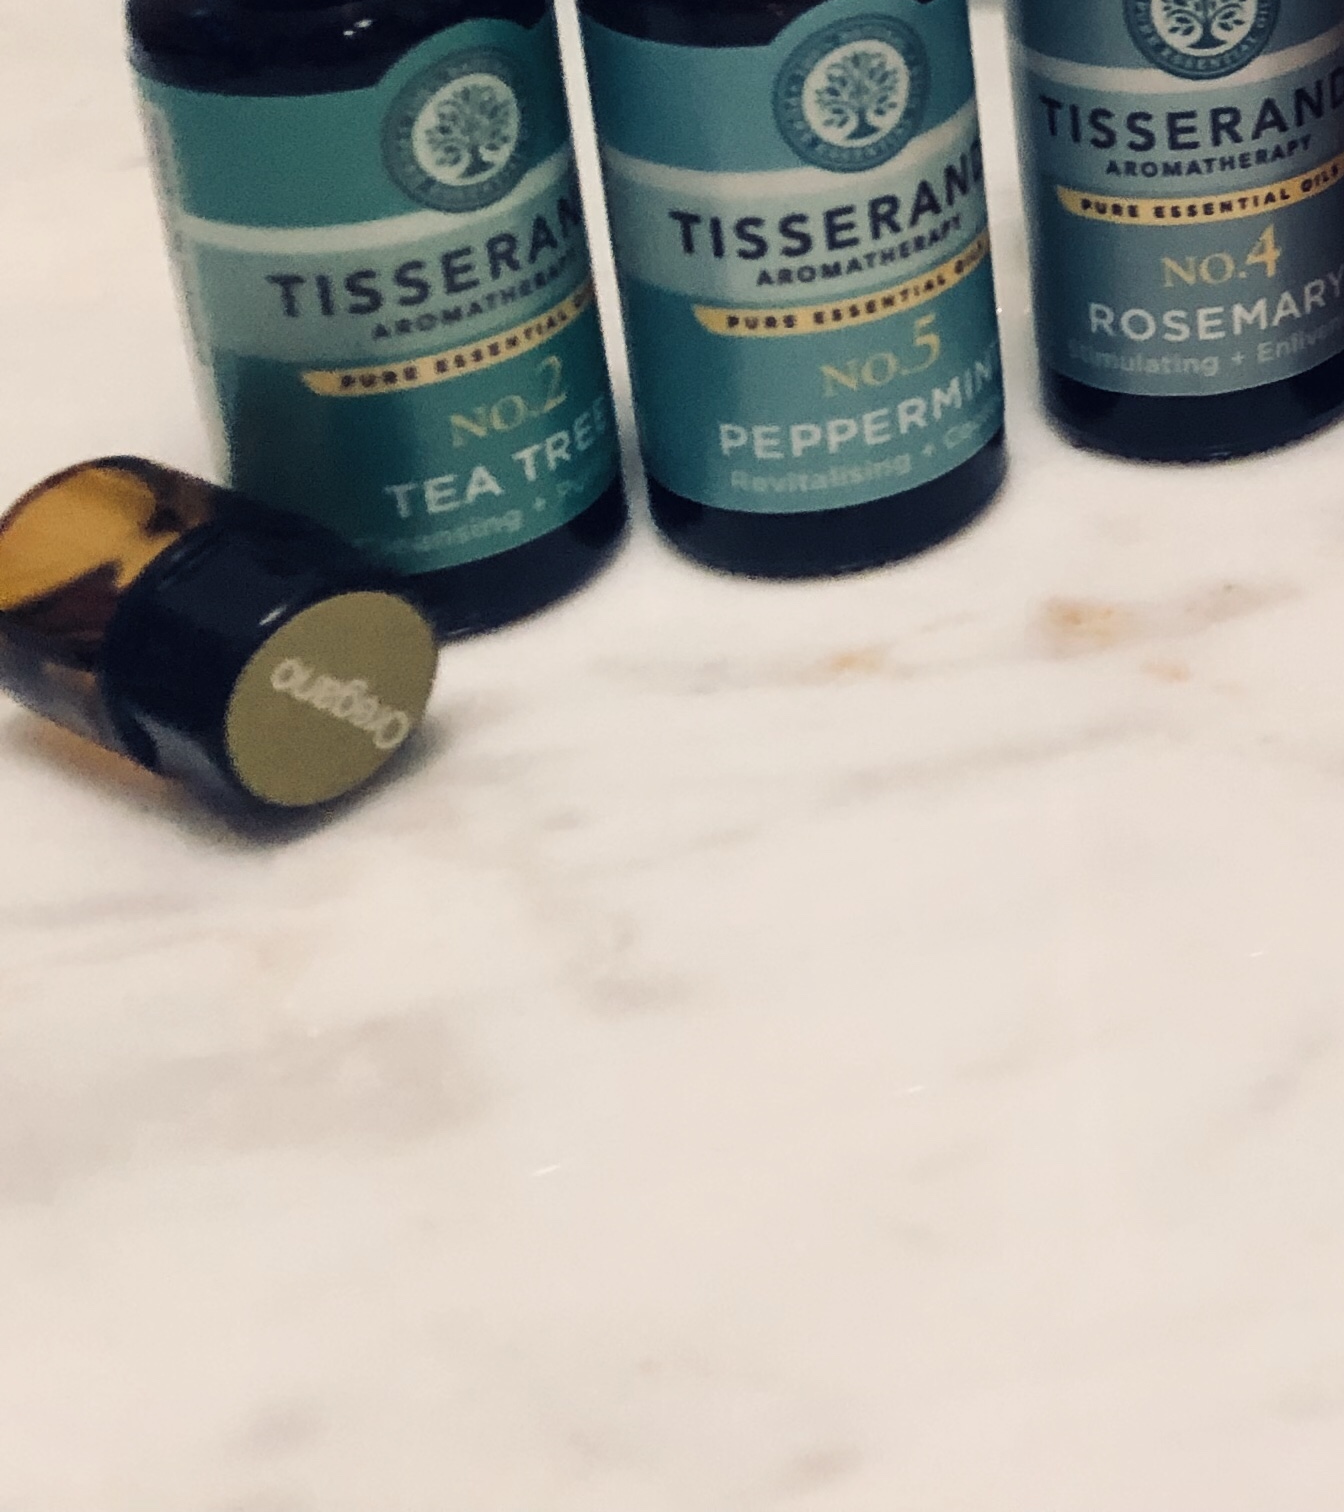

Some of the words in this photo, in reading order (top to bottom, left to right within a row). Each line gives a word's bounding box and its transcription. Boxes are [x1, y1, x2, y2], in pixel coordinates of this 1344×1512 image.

[1081, 199, 1138, 218] PURE
[1154, 188, 1290, 219] ESSENTIAL
[1301, 163, 1340, 192] OILS
[1106, 135, 1312, 178] AROMATHERAPY
[266, 196, 583, 318] TISSERAN
[757, 213, 962, 287] AROMATHERAPY
[726, 314, 796, 329] PURE
[813, 274, 946, 325] ESSENTIAL
[340, 365, 419, 389] PURE
[435, 310, 568, 374] ESSENTIAL
[385, 465, 505, 519] TEA
[512, 393, 607, 482] TREE
[270, 658, 410, 750] Oregano
